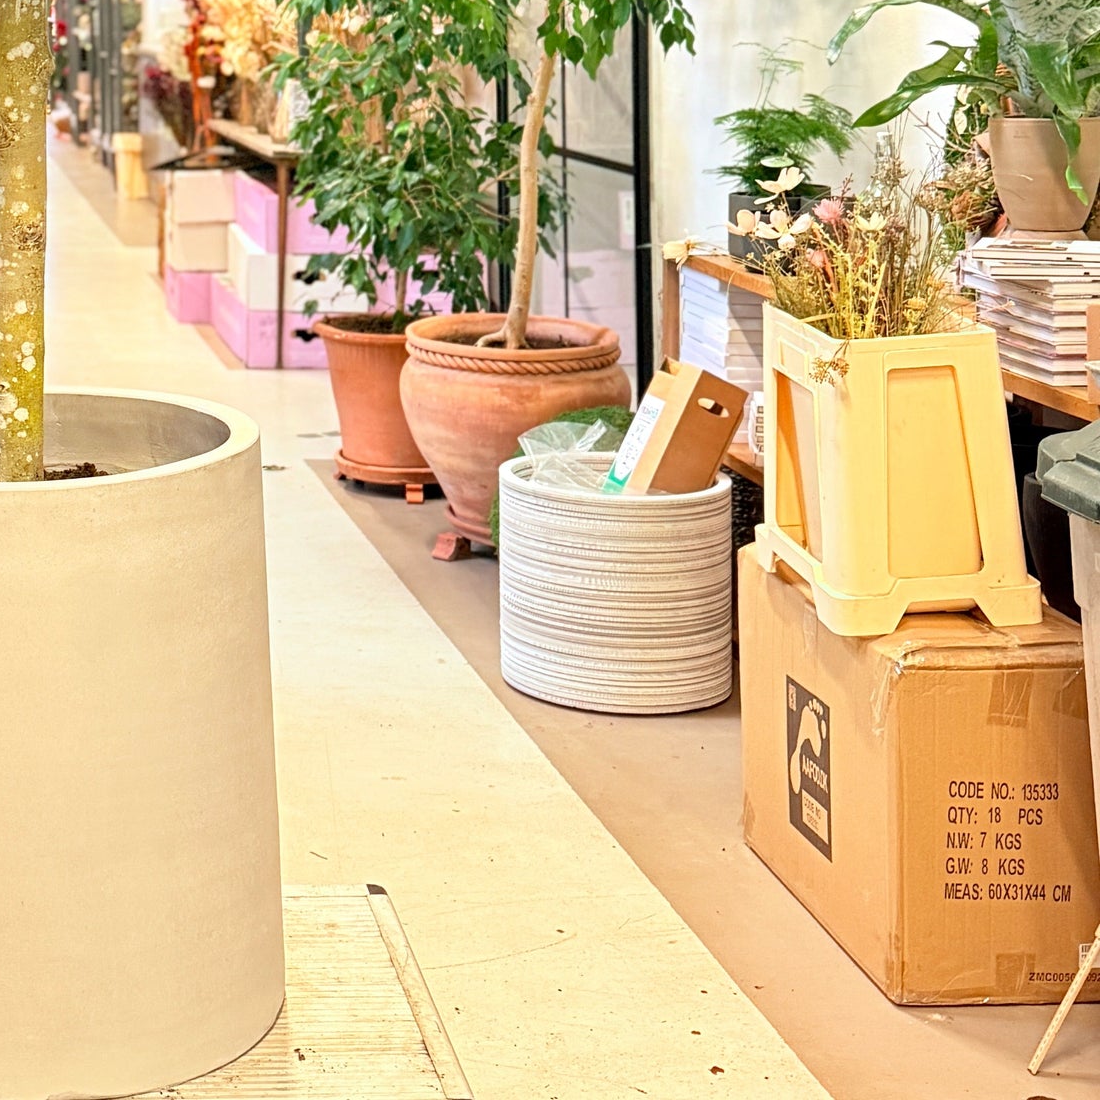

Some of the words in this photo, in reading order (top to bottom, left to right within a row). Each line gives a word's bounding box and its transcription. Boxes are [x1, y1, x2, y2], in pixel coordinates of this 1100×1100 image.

[949, 781, 984, 799] CODE
[991, 782, 1015, 800] NO.:
[1021, 783, 1059, 801] 135333
[948, 806, 978, 824] QTY:
[988, 807, 1001, 823] 18
[1018, 808, 1043, 825] PCS
[946, 832, 973, 849] N.W:
[980, 832, 987, 848] 7
[995, 833, 1022, 850] KGS
[945, 857, 973, 874] G.W:
[981, 858, 988, 875] 8
[998, 858, 1025, 875] KGS
[944, 883, 983, 900] MEAS:
[988, 883, 1046, 900] 60X31X44
[1052, 885, 1071, 902] CM
